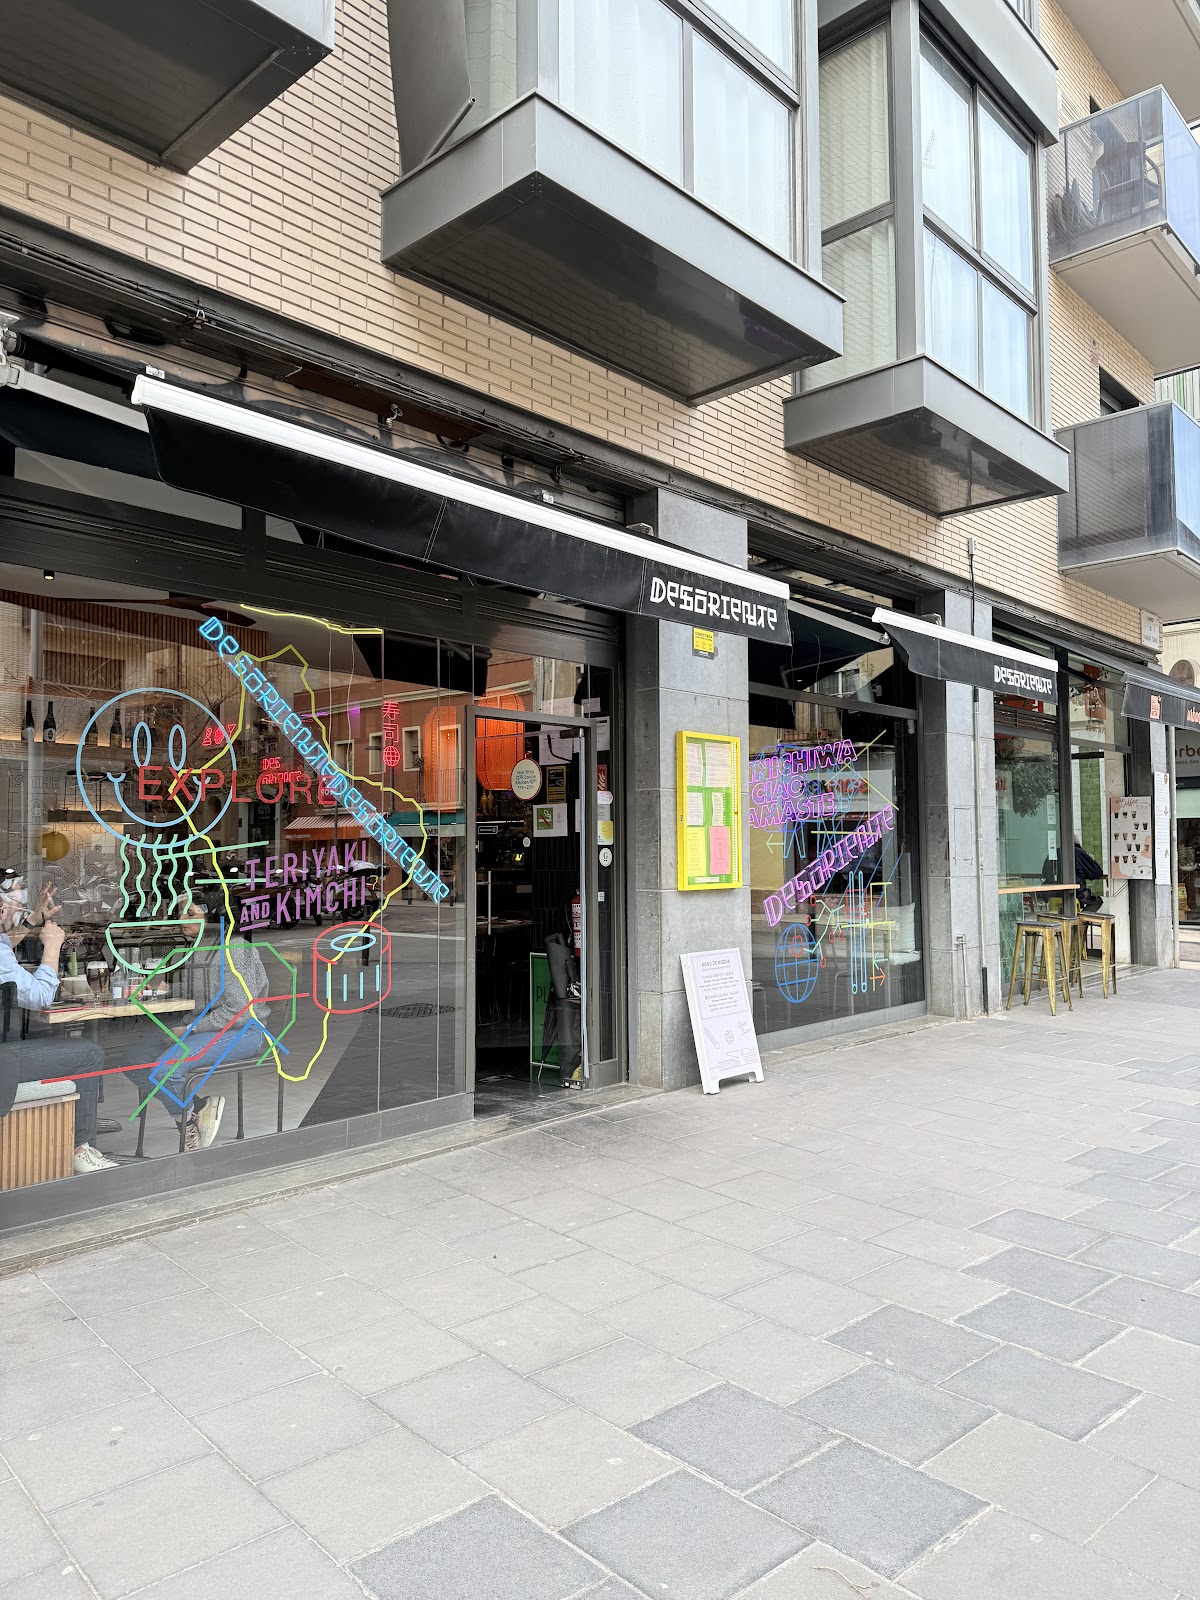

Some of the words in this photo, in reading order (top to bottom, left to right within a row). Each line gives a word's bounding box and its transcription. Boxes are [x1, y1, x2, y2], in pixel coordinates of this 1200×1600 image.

[139, 765, 338, 805] EXPLORE
[749, 739, 858, 784] NICHIWA
[246, 840, 367, 891] TERIYAKI
[240, 901, 270, 924] AND
[276, 876, 367, 925] KIMCHI
